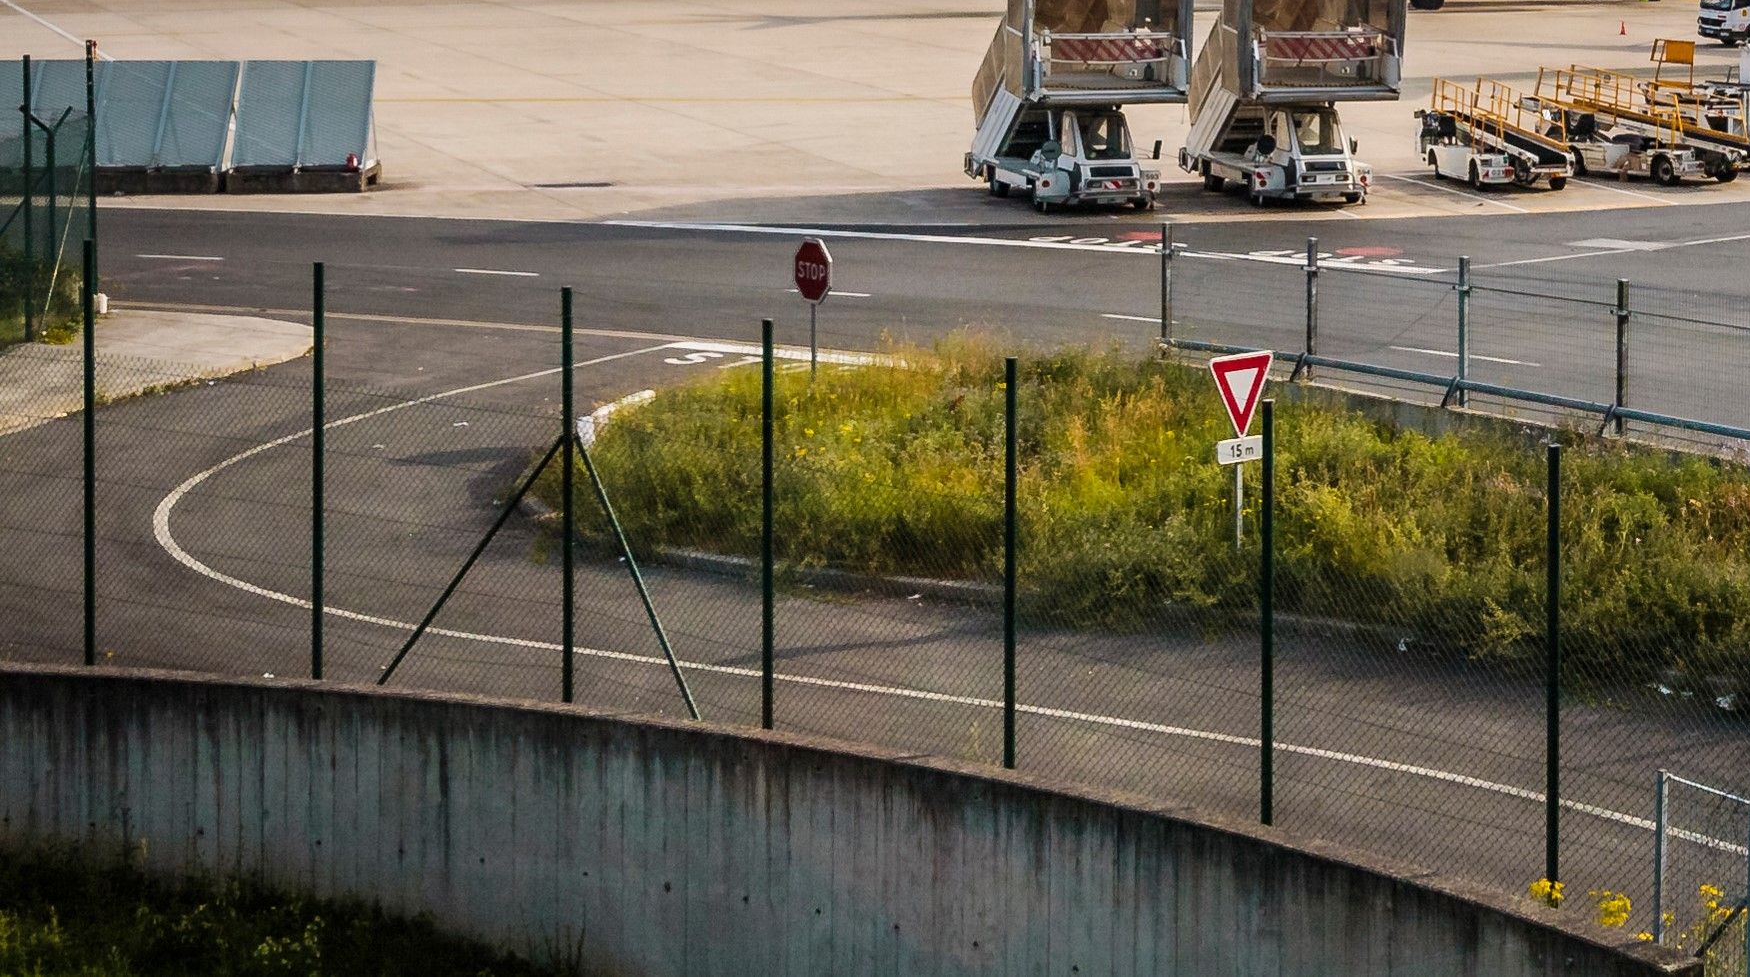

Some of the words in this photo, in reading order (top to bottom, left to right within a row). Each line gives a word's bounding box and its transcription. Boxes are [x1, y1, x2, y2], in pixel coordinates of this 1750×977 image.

[798, 261, 826, 280] STOP
[1231, 444, 1242, 458] 15
[1245, 446, 1254, 455] m
